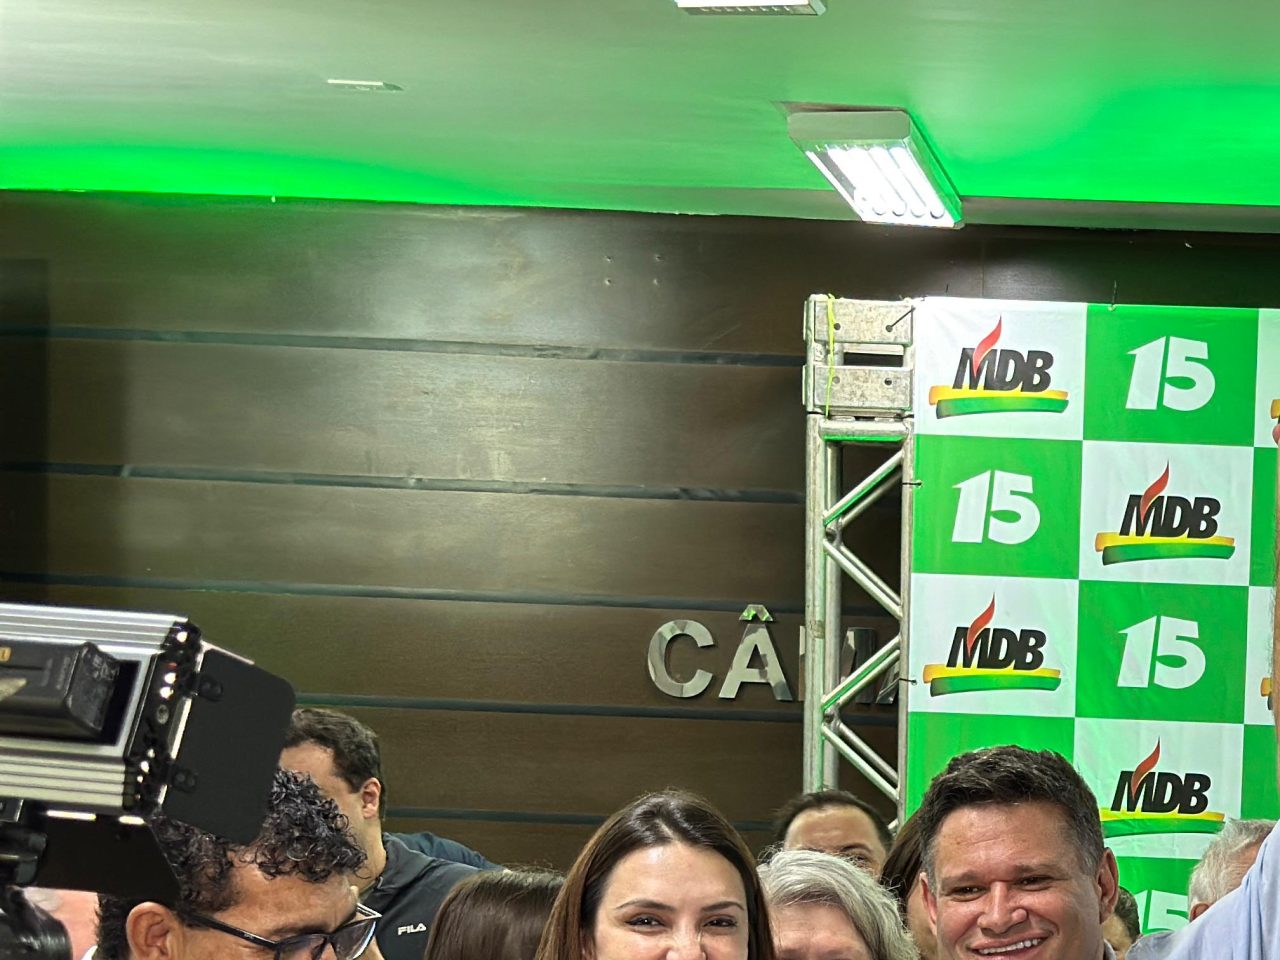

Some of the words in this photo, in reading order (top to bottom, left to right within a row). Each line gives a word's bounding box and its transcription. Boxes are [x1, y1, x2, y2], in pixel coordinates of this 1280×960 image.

[952, 348, 1054, 392] MDB
[1126, 337, 1216, 411] 15
[951, 470, 1041, 545] 15
[1119, 494, 1221, 539] MDB
[946, 626, 1047, 671] MDB
[1118, 616, 1206, 689] 15
[1110, 770, 1211, 815] MDB
[397, 923, 427, 936] FILA
